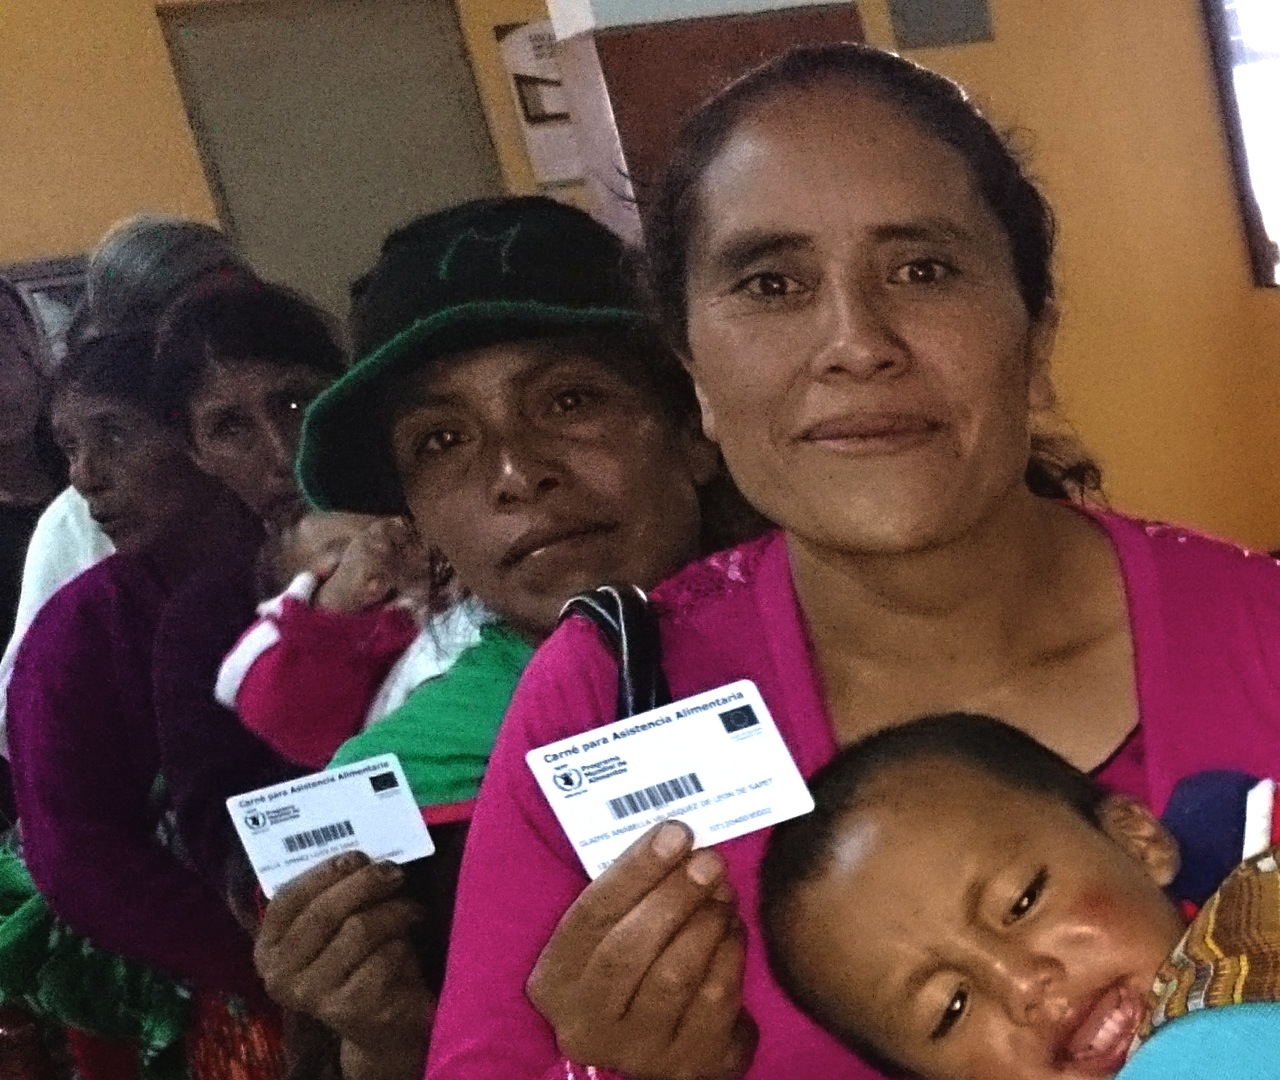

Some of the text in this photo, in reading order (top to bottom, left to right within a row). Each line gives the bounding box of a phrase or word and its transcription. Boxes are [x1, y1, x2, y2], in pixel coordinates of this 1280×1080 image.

[543, 690, 745, 764] Carné para Asistencia Alimentaria
